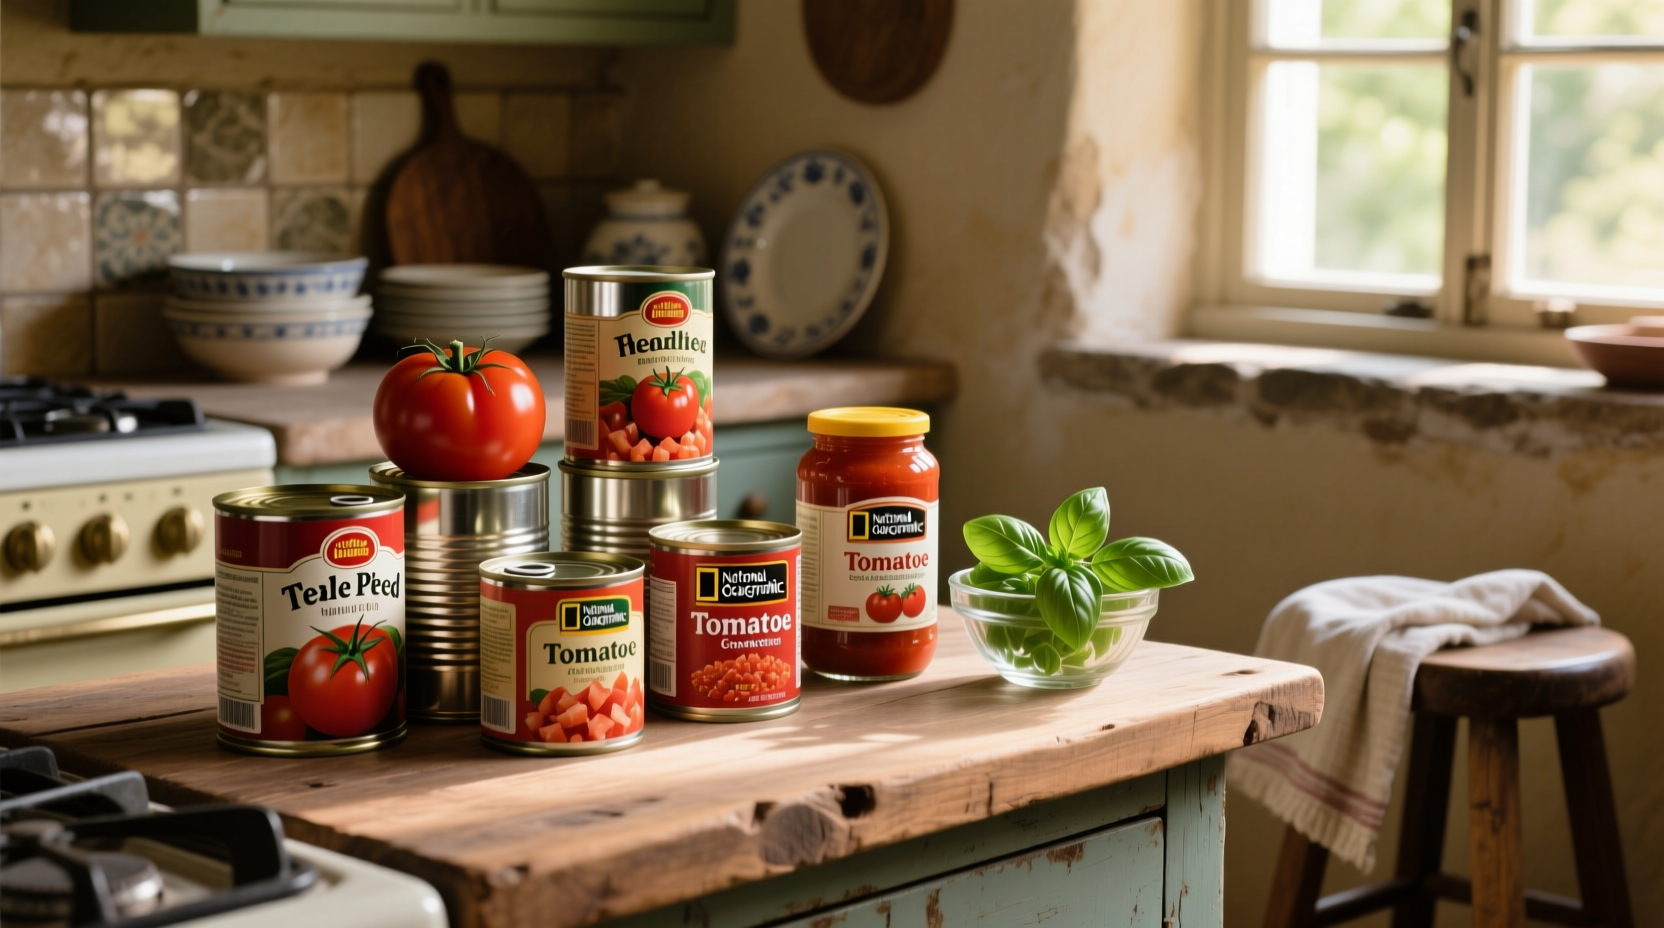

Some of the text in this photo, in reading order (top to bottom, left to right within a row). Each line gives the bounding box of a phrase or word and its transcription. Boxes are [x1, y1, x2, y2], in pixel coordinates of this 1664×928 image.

[843, 552, 929, 571] Tomatoe
[690, 612, 792, 636] Tomatoe
[543, 640, 637, 665] Tomatoe
